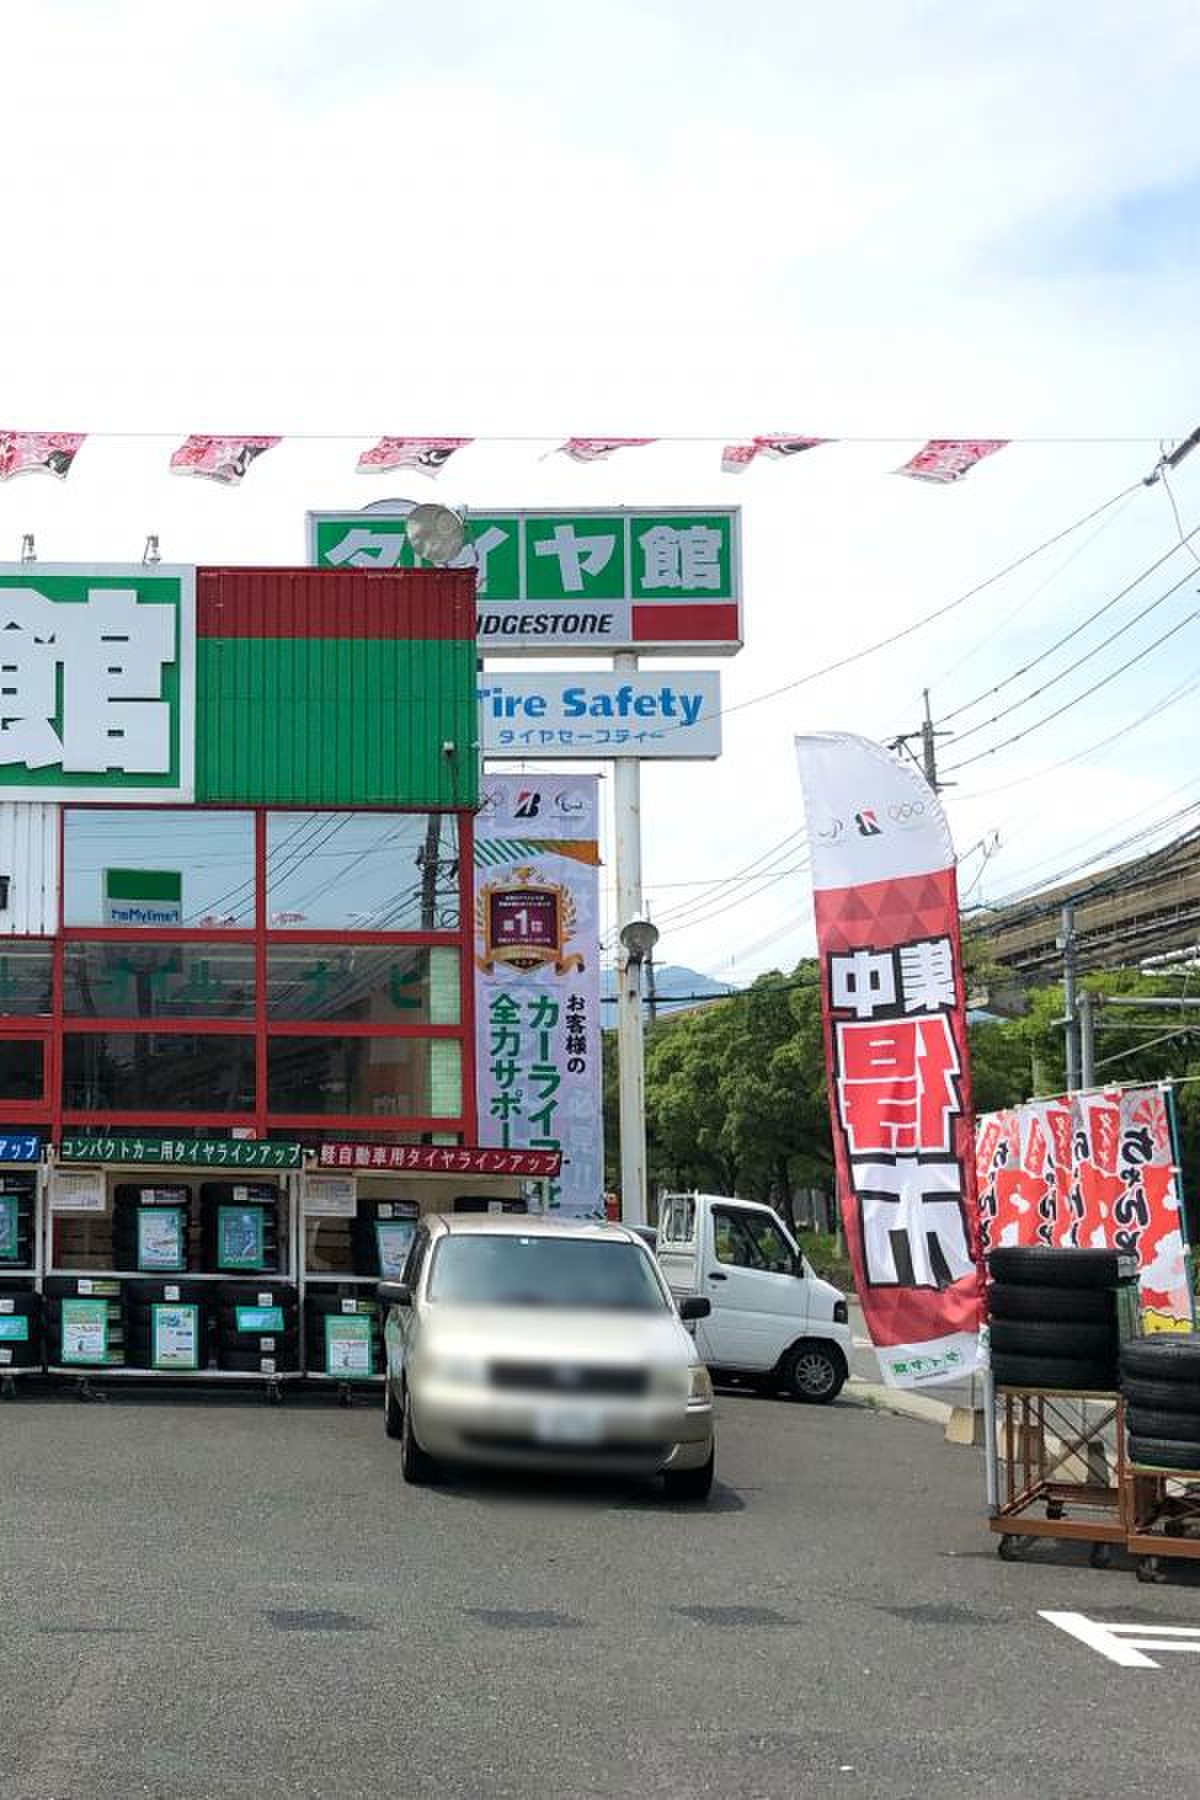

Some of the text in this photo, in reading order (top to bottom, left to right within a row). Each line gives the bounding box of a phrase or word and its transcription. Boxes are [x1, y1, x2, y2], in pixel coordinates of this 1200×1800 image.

[562, 685, 703, 727] Safety
[565, 993, 587, 1075] お客様の
[489, 992, 522, 1150] 全力サポー
[61, 1139, 301, 1165] コンパクトカー用タイヤラインアップ
[319, 1143, 559, 1174] 軽自動車用タイヤラインアップ
